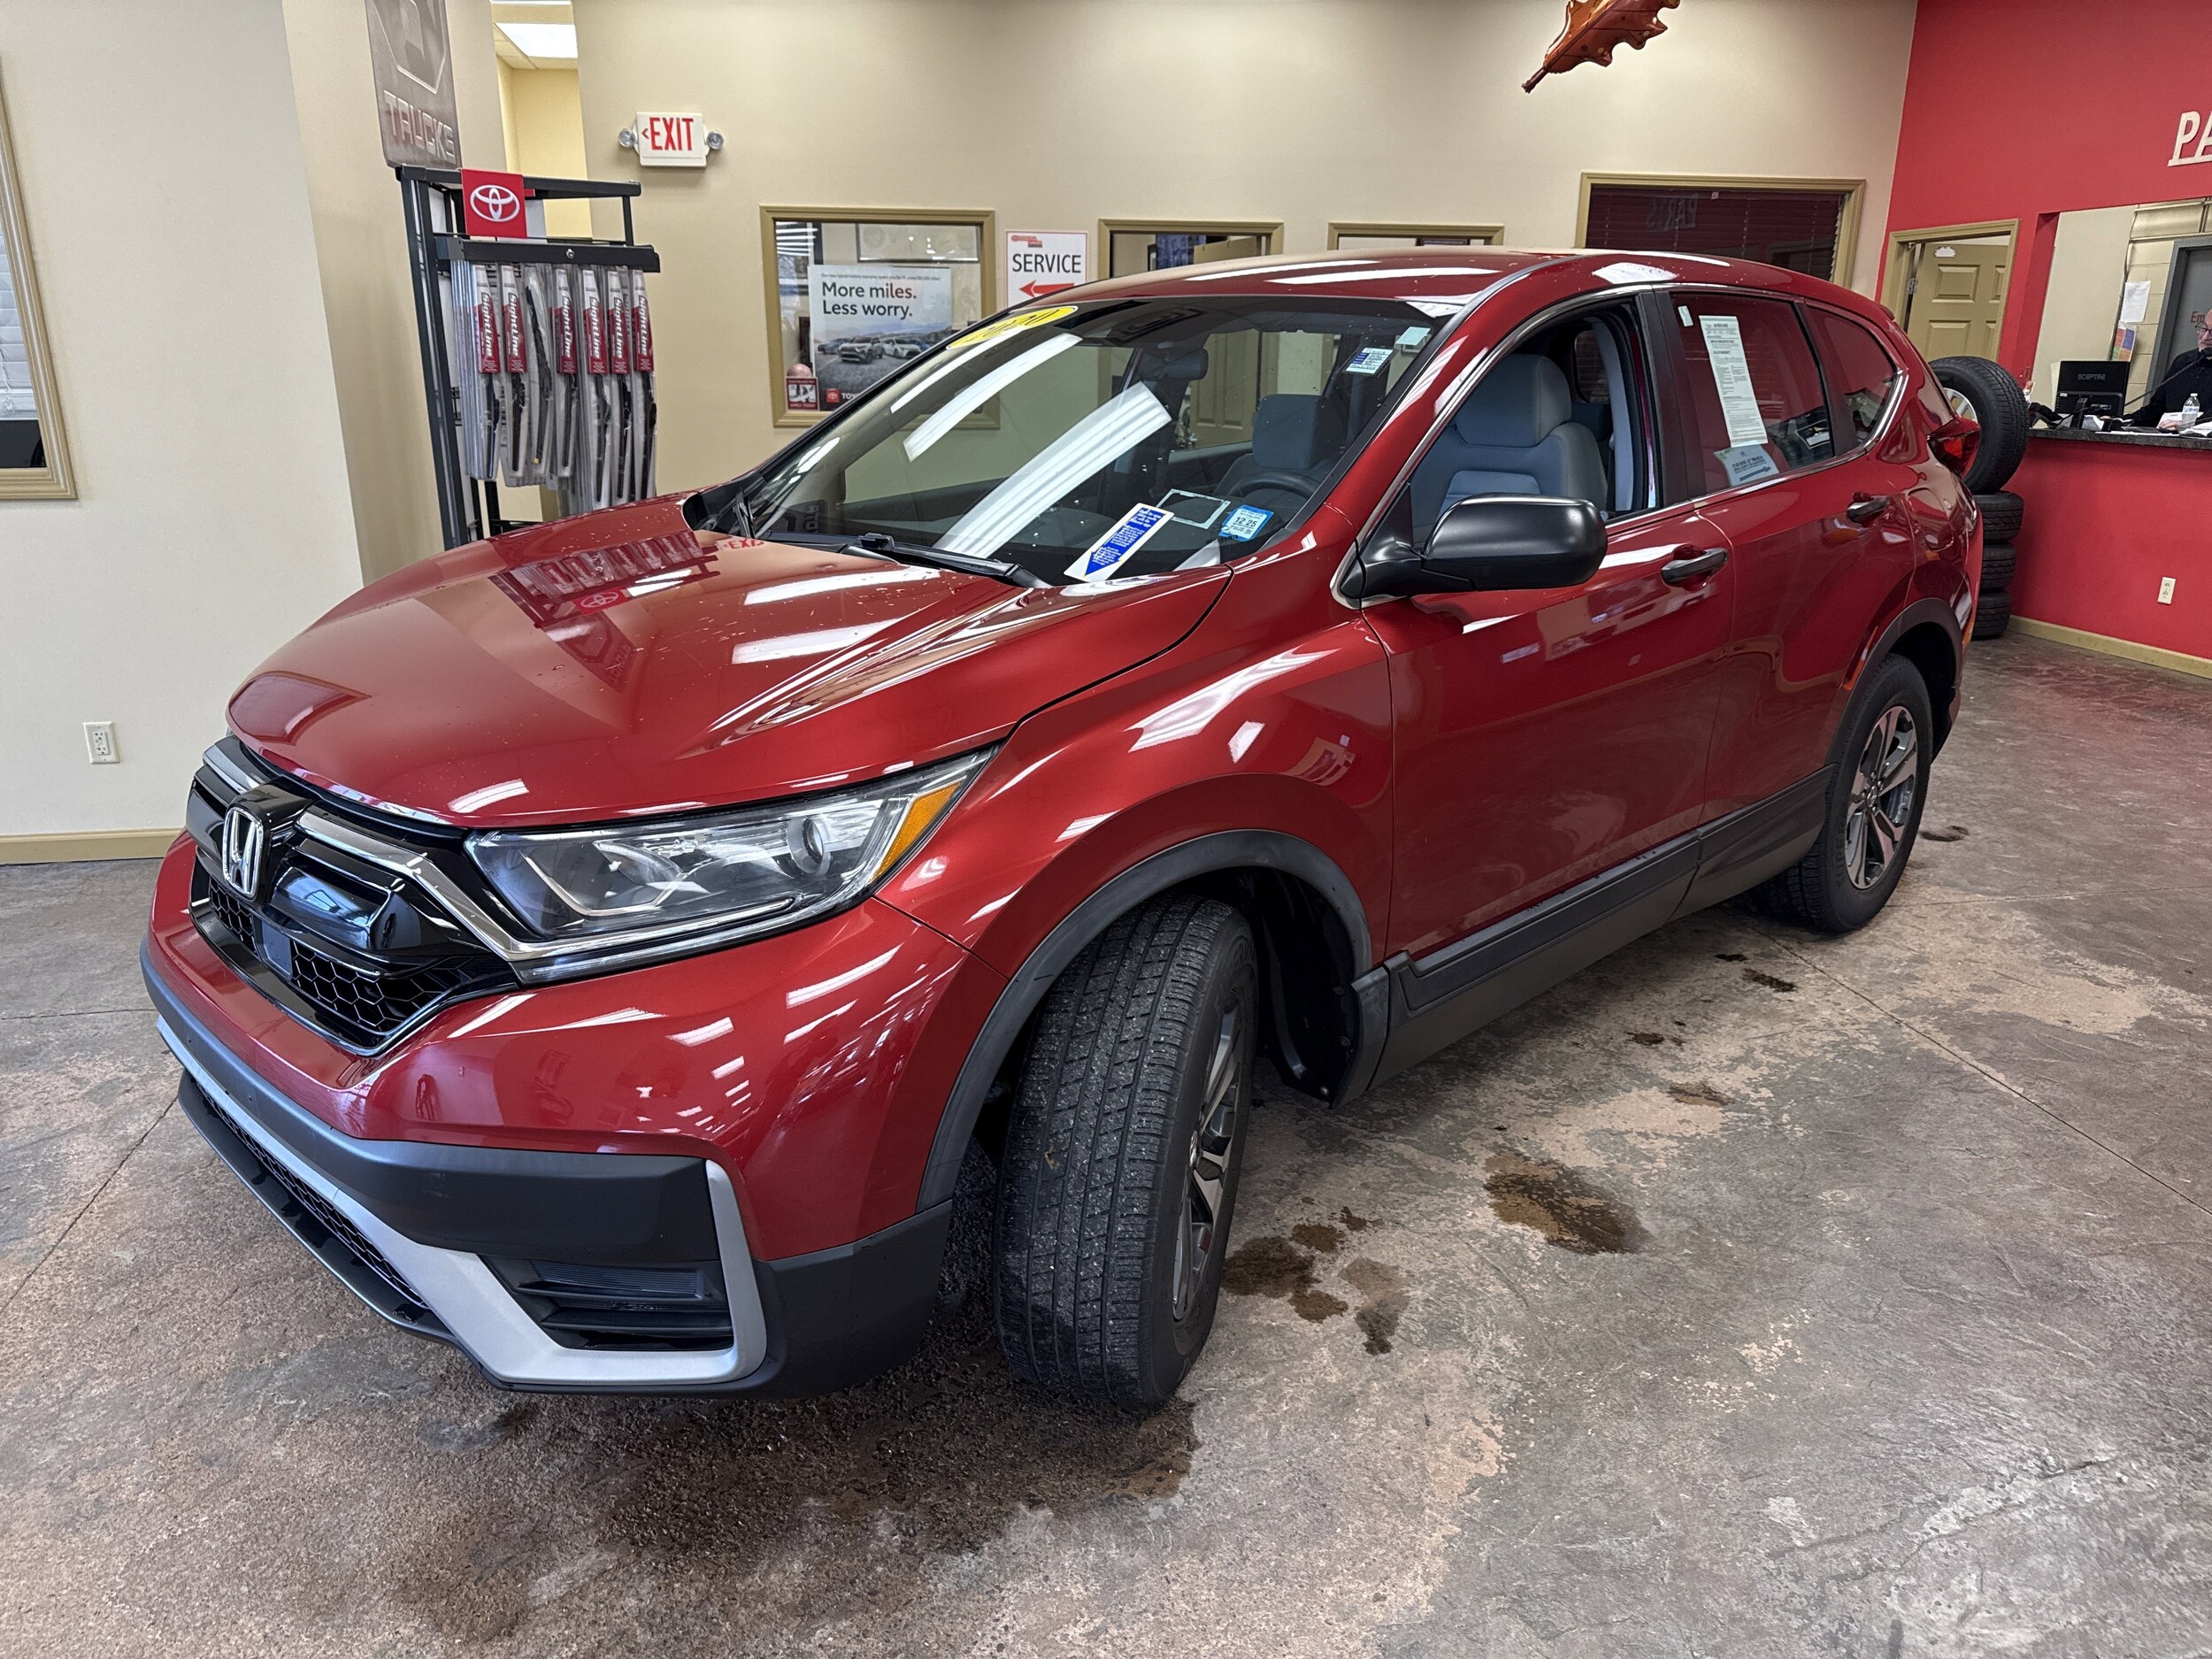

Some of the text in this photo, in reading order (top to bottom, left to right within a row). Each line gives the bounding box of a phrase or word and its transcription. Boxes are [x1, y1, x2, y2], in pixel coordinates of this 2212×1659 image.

[383, 89, 457, 165] TRUCKS
[649, 116, 695, 151] EXIT
[822, 281, 918, 299] More miles.
[1012, 253, 1081, 273] SERVICE
[481, 292, 493, 357] SightLine
[508, 292, 519, 357] SightLine
[590, 296, 601, 358] SightLine
[614, 296, 624, 359] SightLine
[638, 295, 649, 356] SightLine
[823, 299, 913, 320] Less worry.
[1235, 517, 1258, 528] 12 25
